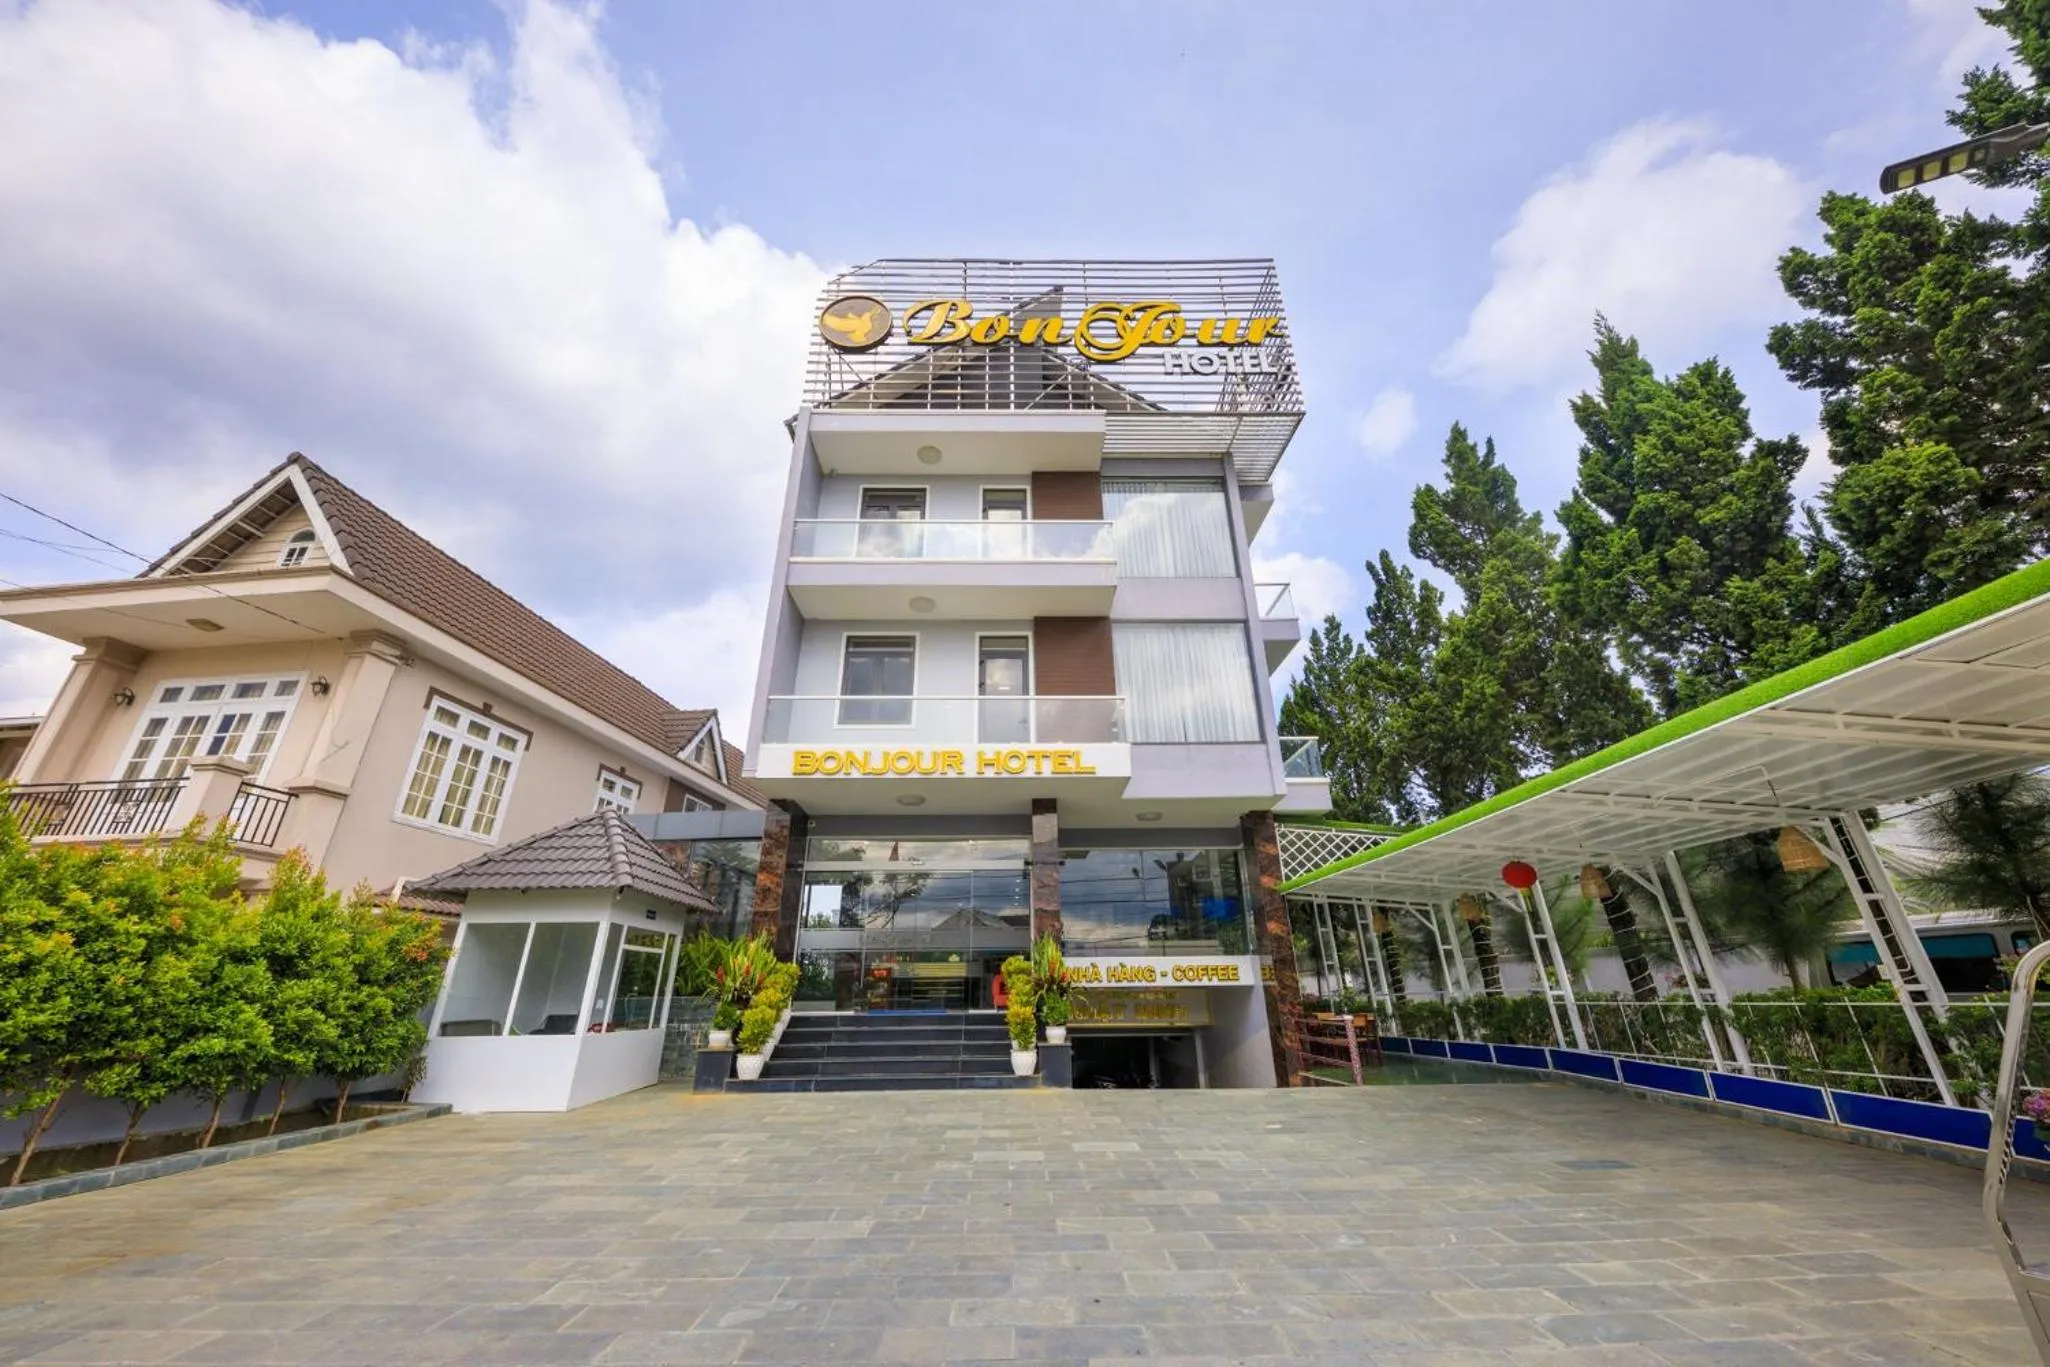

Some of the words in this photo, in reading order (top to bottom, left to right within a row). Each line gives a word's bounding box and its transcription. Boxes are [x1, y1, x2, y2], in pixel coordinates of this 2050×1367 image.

[1163, 349, 1280, 375] HOTEL
[791, 749, 965, 776] BONJOUR
[976, 749, 1097, 775] HOTEL
[1067, 962, 1102, 983] NHÀ
[1107, 961, 1157, 983] HÀNG
[1172, 964, 1240, 982] COFFEE
